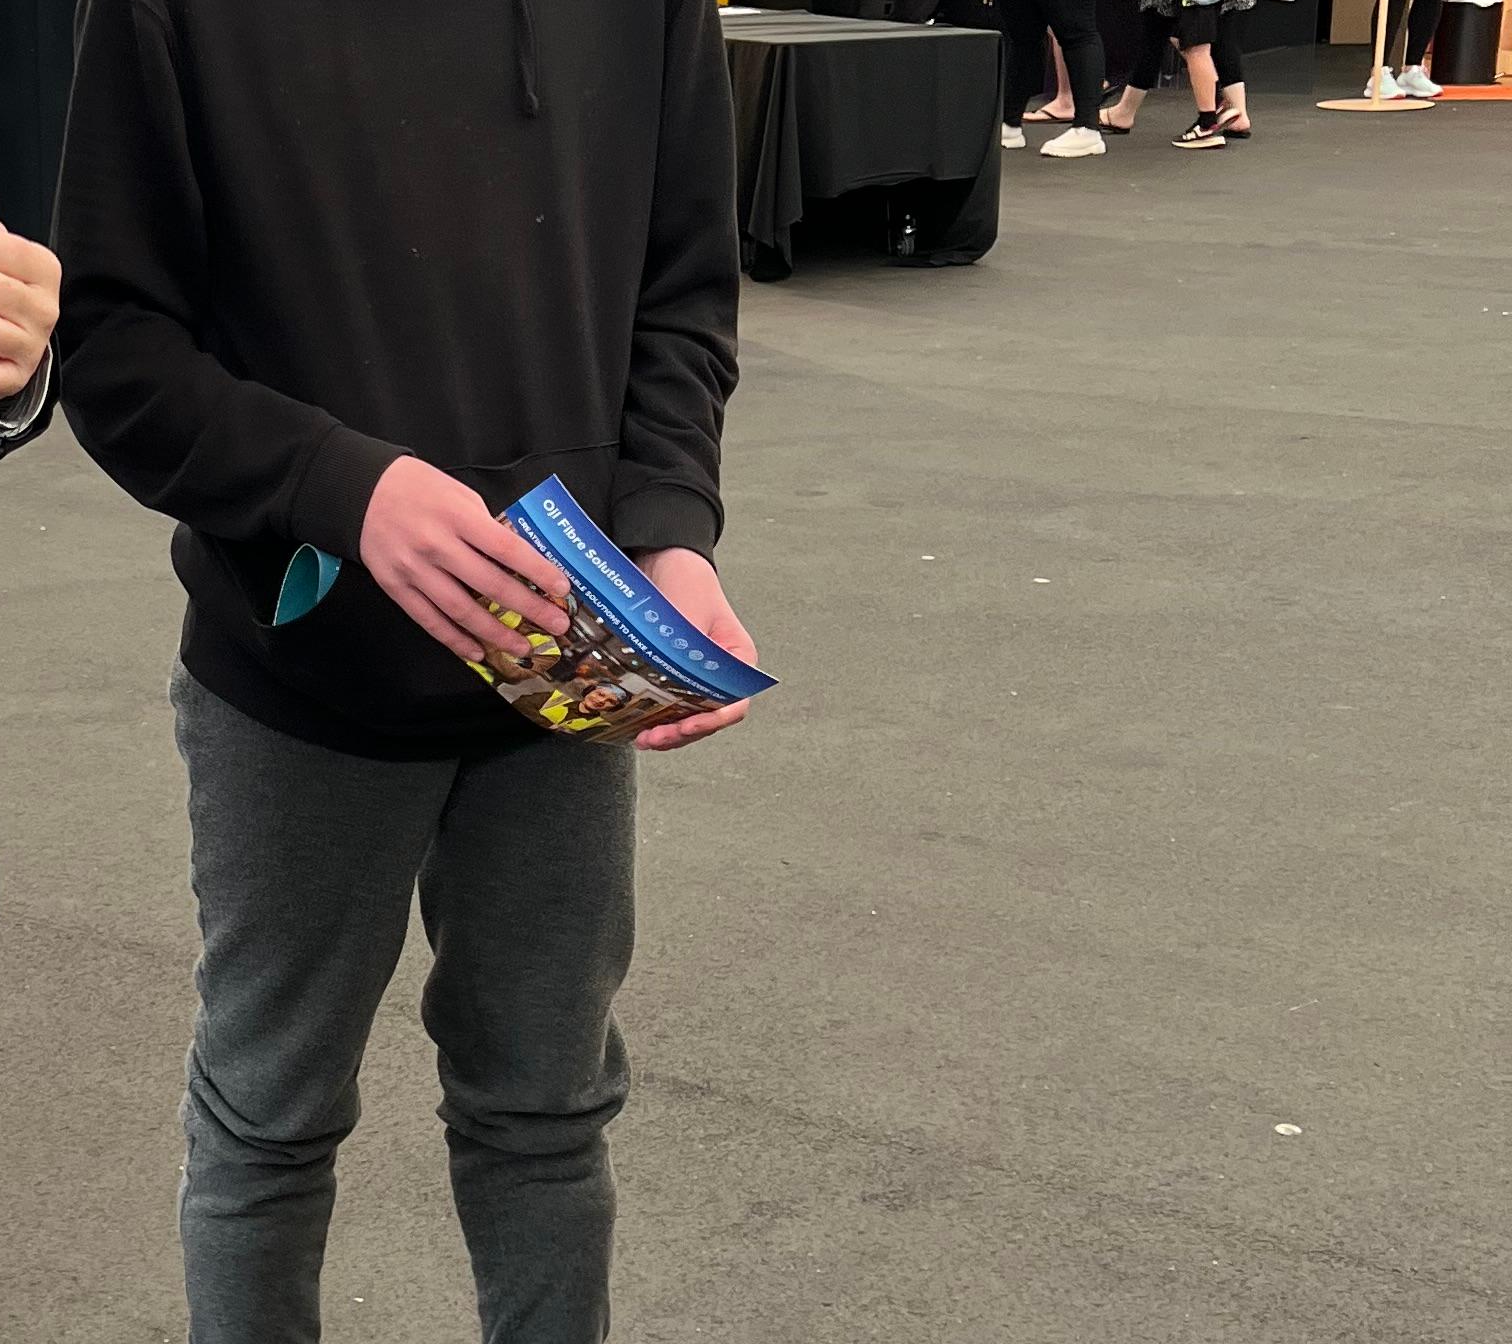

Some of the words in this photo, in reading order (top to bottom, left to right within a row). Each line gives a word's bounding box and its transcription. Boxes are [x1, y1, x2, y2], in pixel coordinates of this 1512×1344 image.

[517, 517, 547, 552] CREATING
[544, 551, 588, 592] SUSTAINABLE
[584, 590, 621, 626] SOLUTIONS
[618, 623, 630, 635] TO
[627, 632, 648, 653] MAKE
[645, 650, 653, 658] A
[543, 499, 563, 520] Oji
[557, 518, 586, 551] Fibre
[584, 549, 636, 599] Solutions
